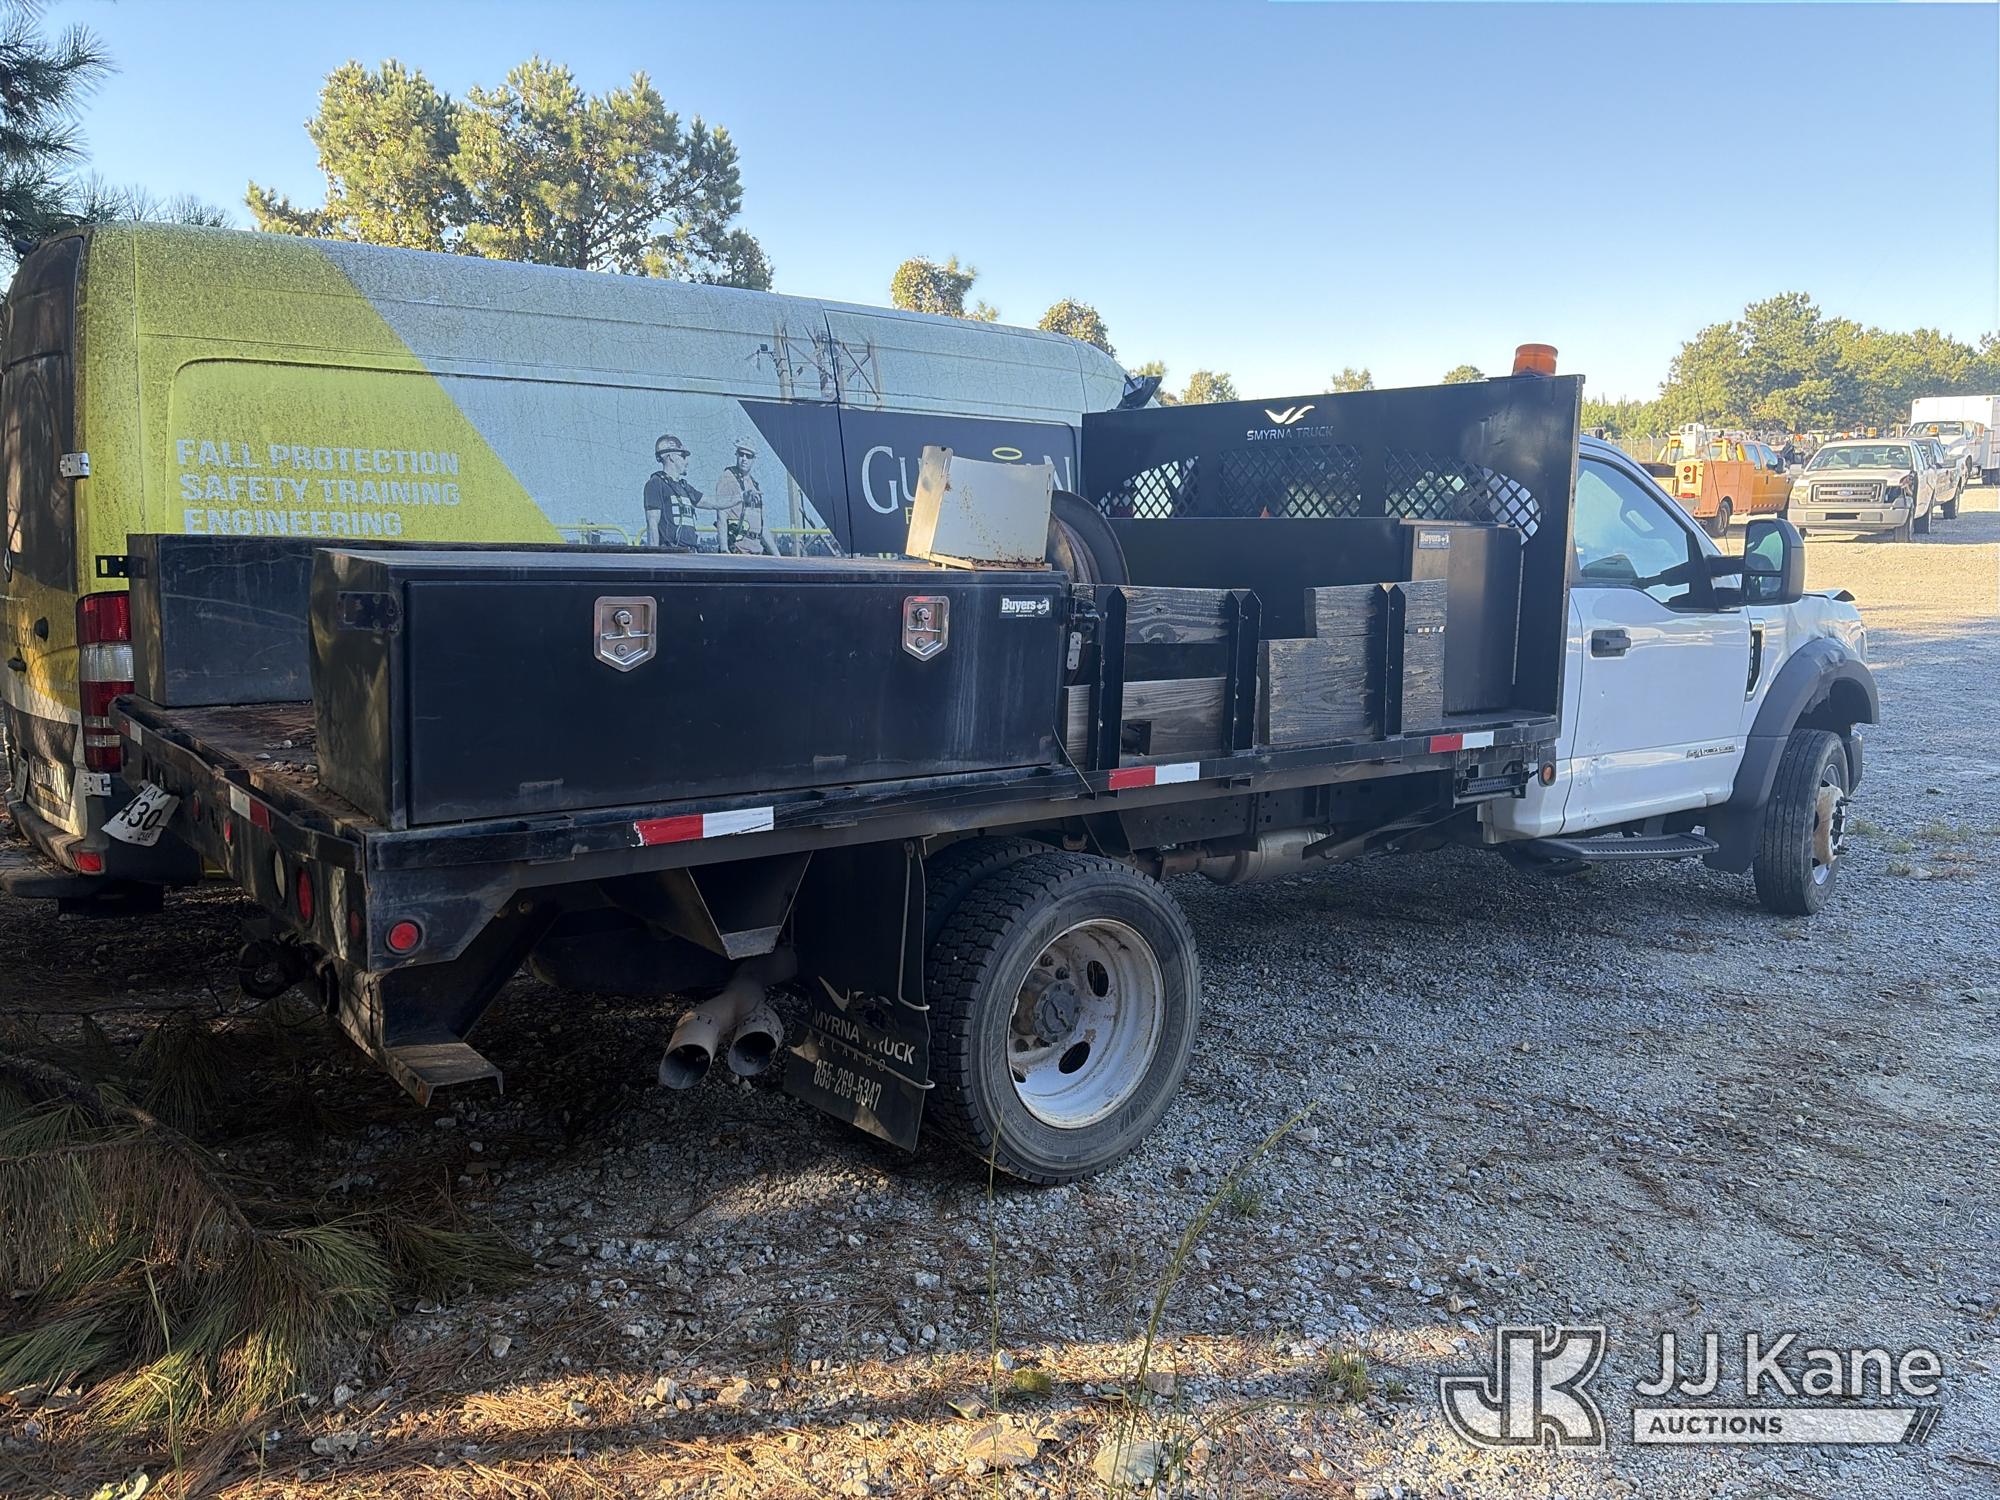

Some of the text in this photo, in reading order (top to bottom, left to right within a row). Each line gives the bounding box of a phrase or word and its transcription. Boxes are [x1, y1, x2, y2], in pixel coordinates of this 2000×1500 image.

[1246, 425, 1334, 441] SMYRNA TRUCK
[175, 439, 460, 476] FALL PROTECTION
[179, 474, 461, 506] SAFETY TRAINING
[183, 508, 401, 537] ENGINEERING
[1001, 597, 1036, 613] Buyers
[811, 1008, 861, 1044] MYRNA
[813, 1058, 882, 1112] 855-269-5347
